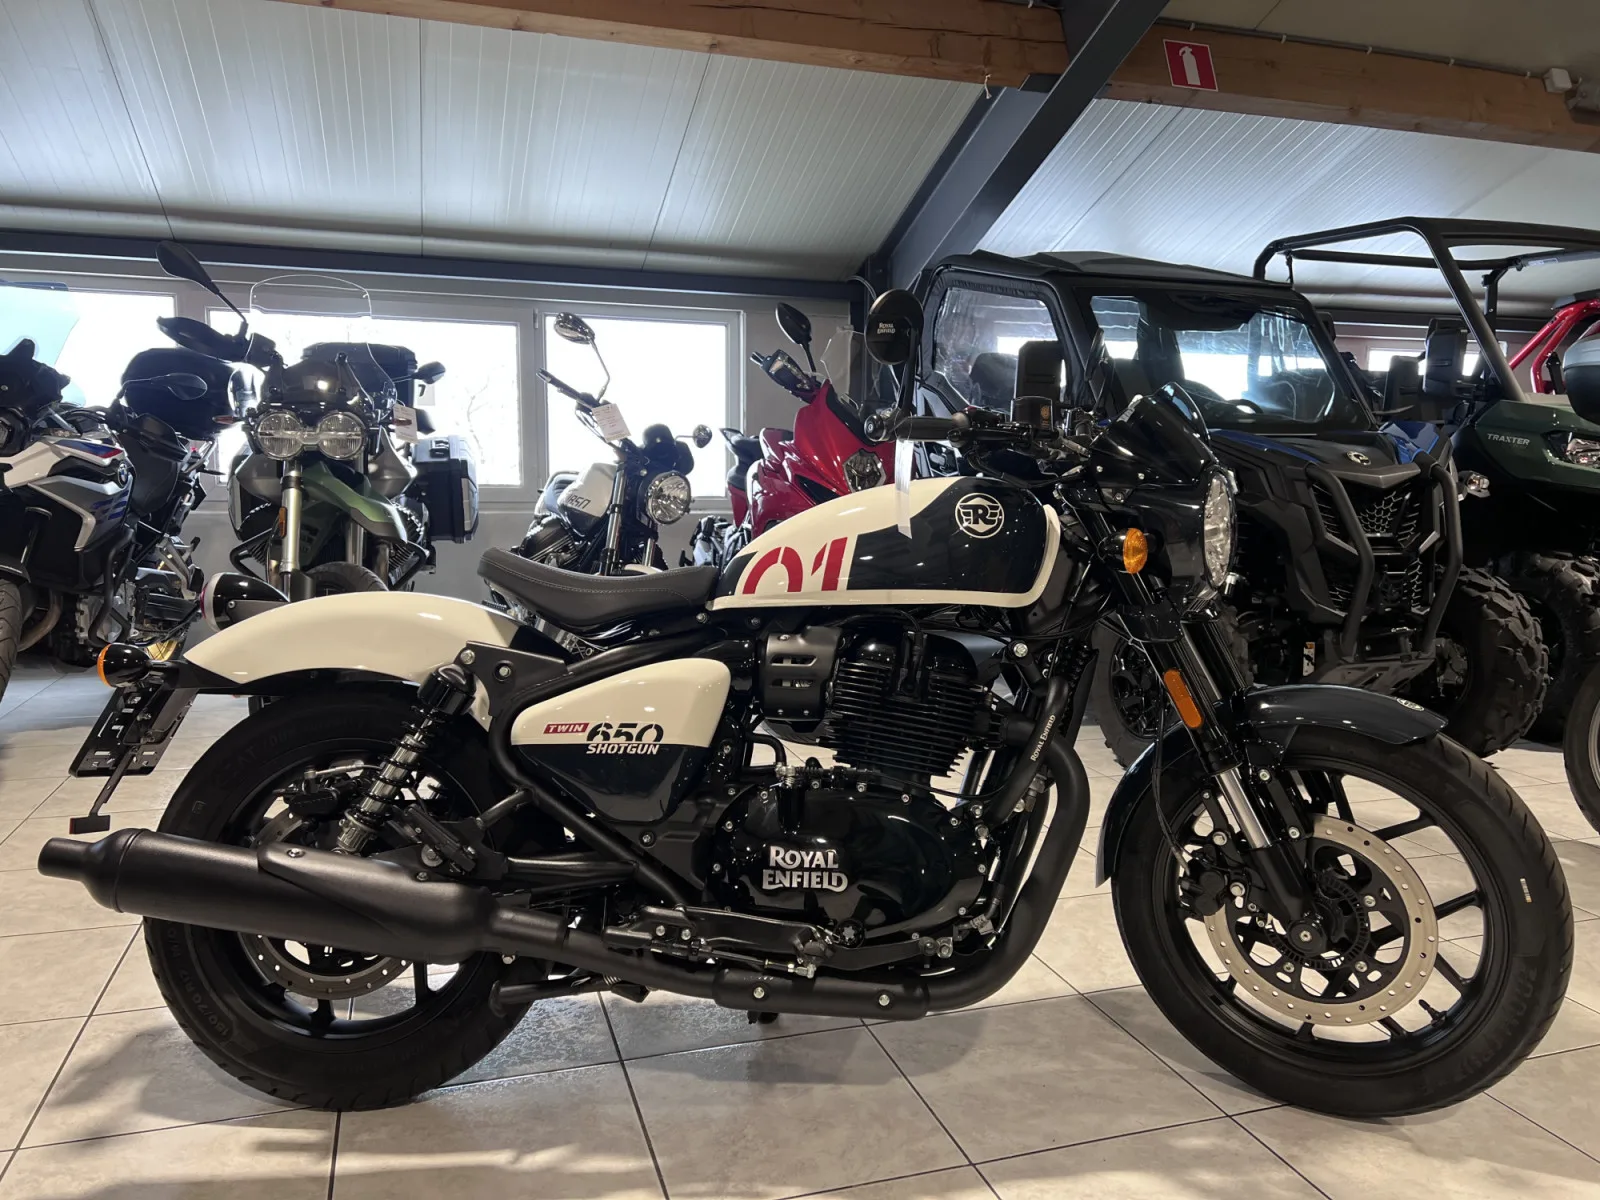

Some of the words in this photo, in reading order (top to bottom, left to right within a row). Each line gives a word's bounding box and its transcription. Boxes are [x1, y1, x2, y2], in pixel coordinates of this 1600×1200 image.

[1487, 433, 1531, 445] TRAXTER
[548, 724, 585, 734] TWIN
[586, 722, 664, 742] 650
[1030, 740, 1045, 762] ROYAL
[1040, 714, 1056, 741] ENFIELD
[586, 743, 660, 755] SHOTGUN
[769, 845, 839, 870] ROYAL
[762, 869, 849, 893] ENFIELD
